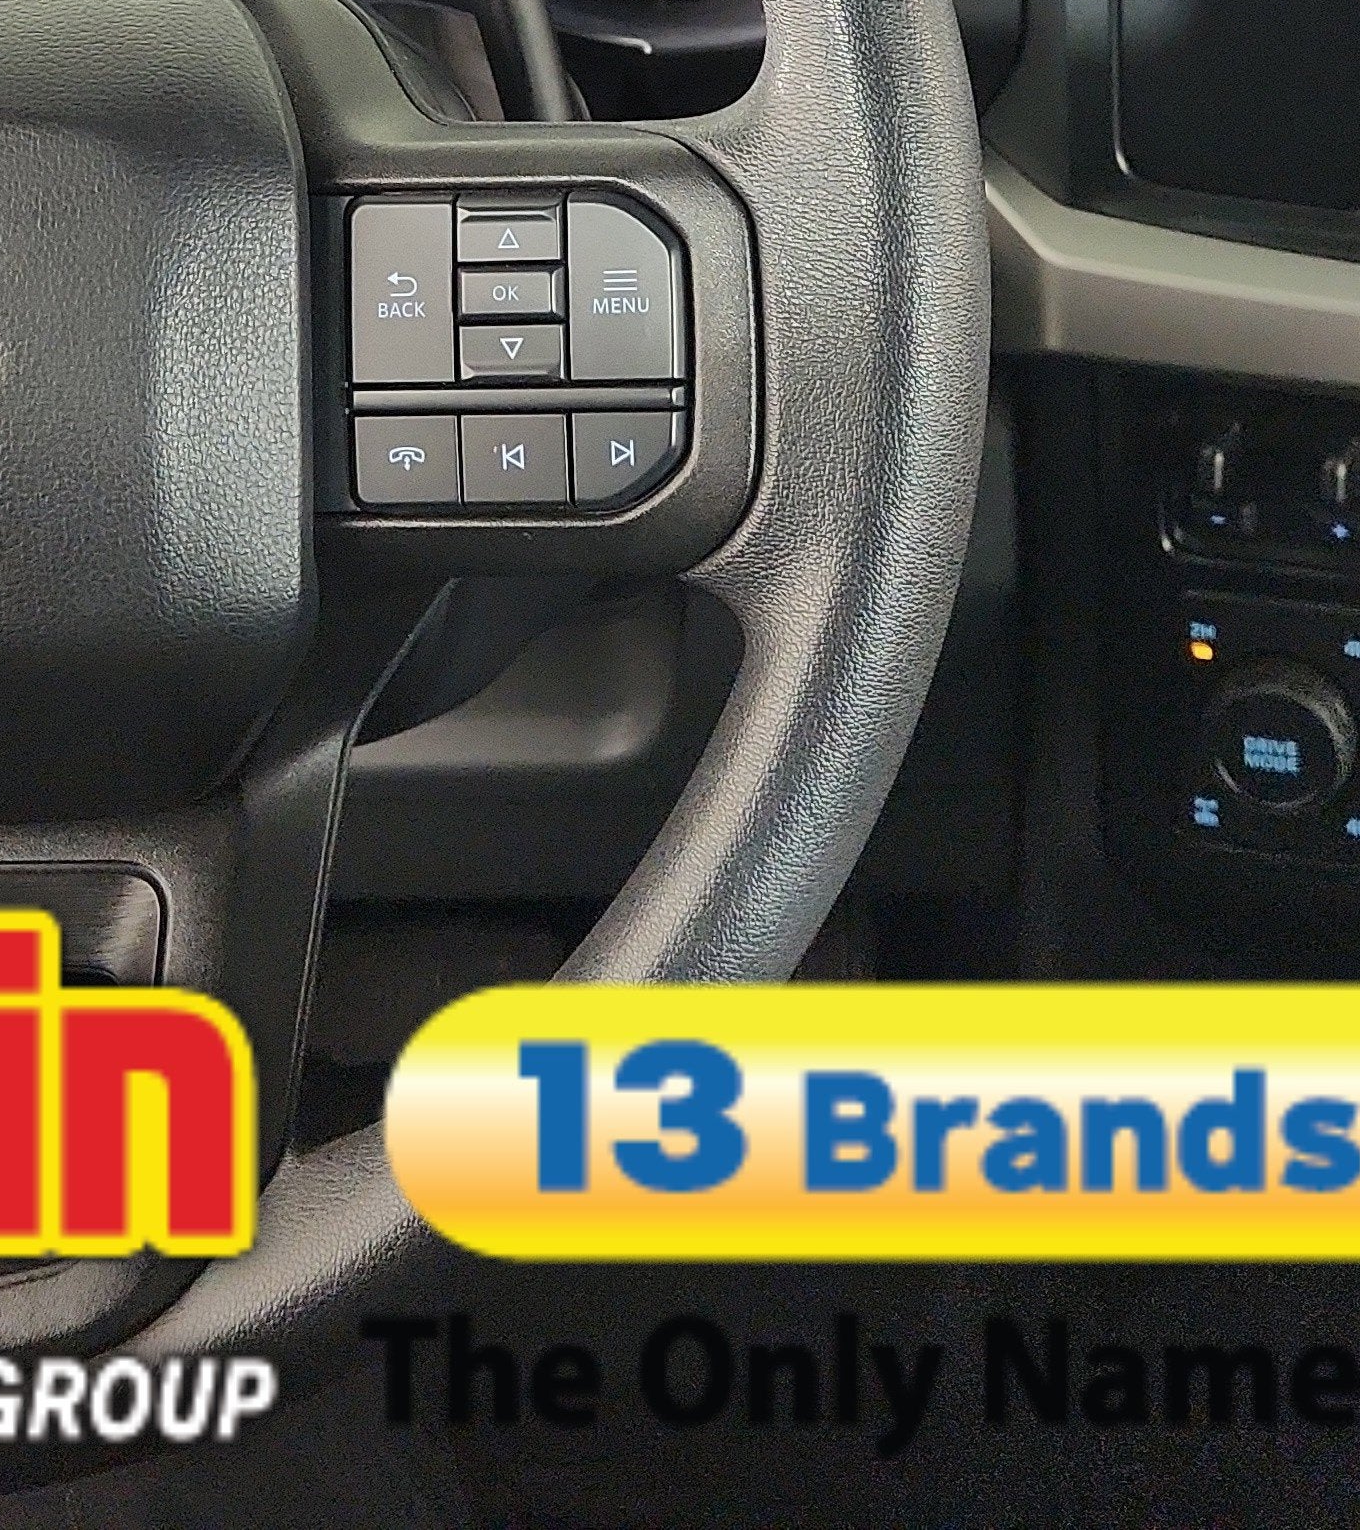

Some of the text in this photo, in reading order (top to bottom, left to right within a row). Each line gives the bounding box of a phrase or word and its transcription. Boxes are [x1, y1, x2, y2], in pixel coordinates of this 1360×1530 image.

[492, 285, 519, 302] OK
[377, 302, 426, 318] BACK
[592, 297, 650, 315] MENU
